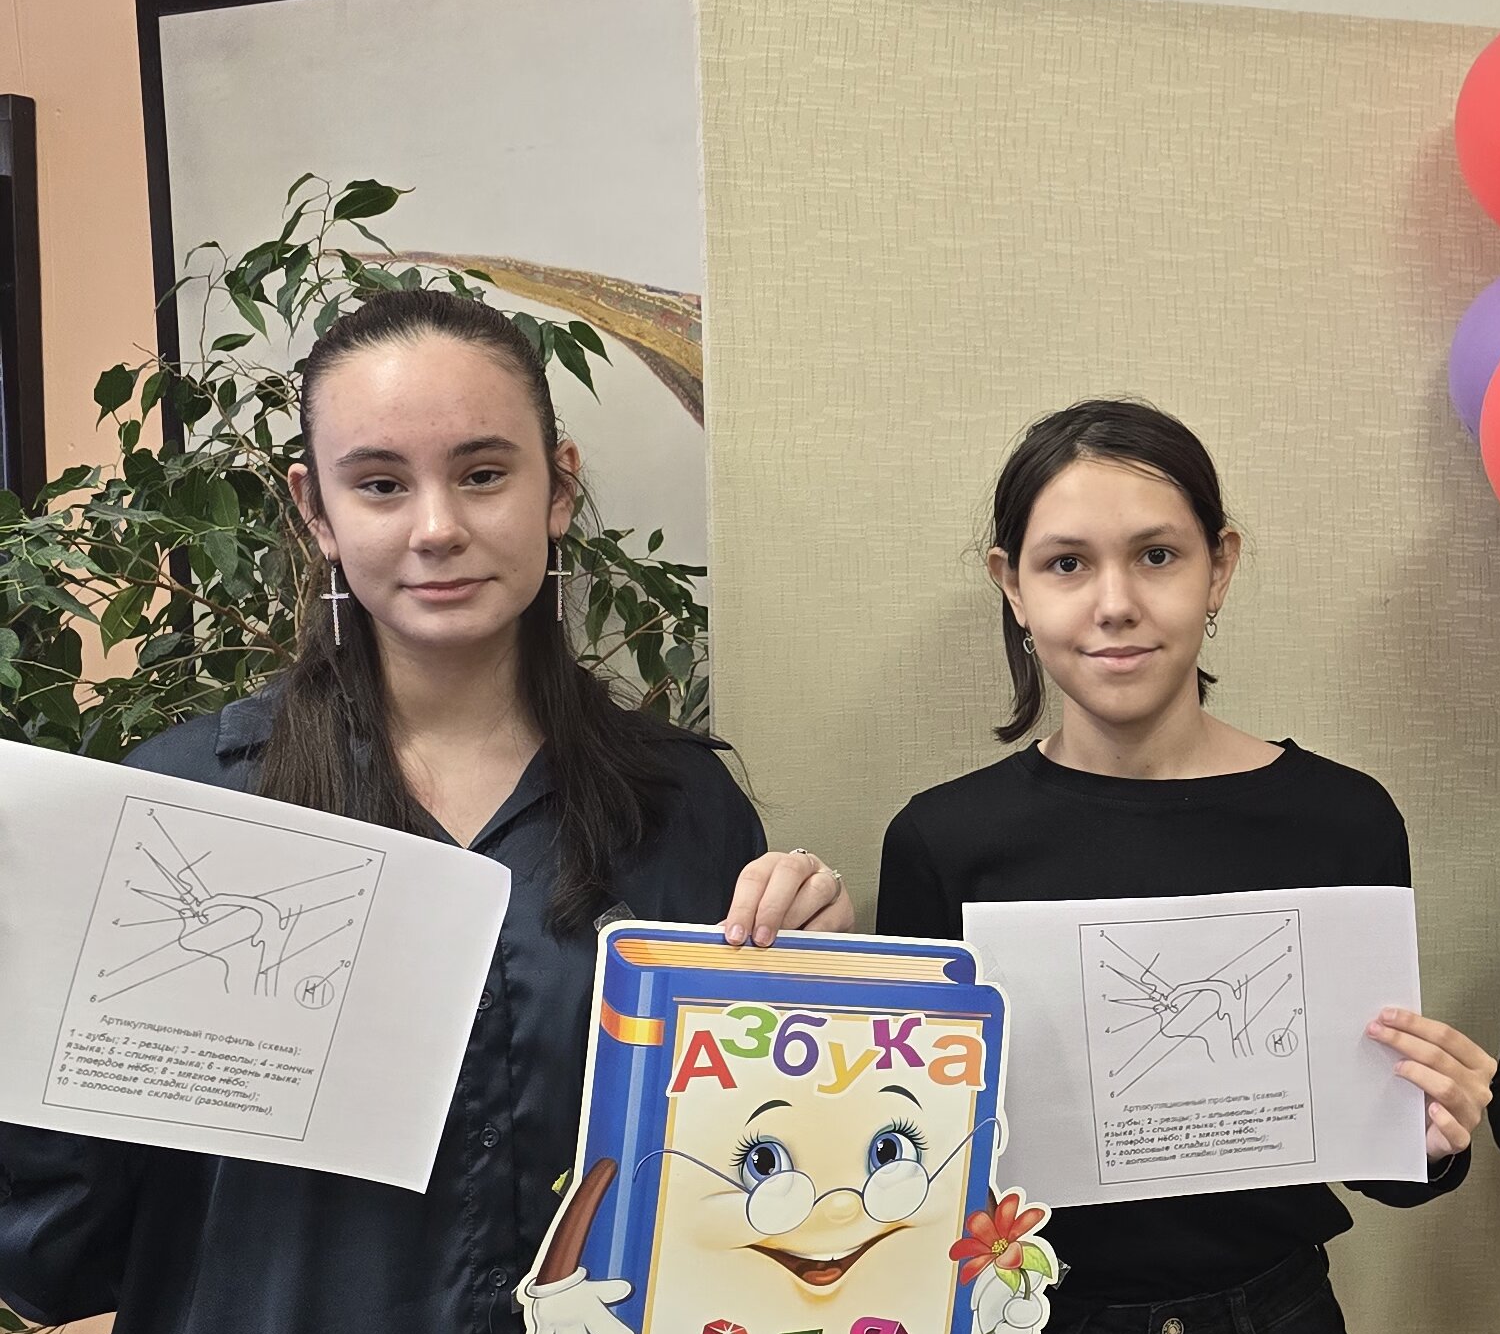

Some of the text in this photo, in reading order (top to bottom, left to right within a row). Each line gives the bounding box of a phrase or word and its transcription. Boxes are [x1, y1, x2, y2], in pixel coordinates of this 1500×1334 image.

[100, 1014, 302, 1056] Артикуляционный профиль (схема):
[671, 1007, 983, 1094] Азбука
[56, 1076, 69, 1086] 10
[80, 1081, 143, 1096] голосовые
[147, 1089, 192, 1102] складки
[76, 1068, 139, 1083] голосовые
[144, 1078, 188, 1090] складки
